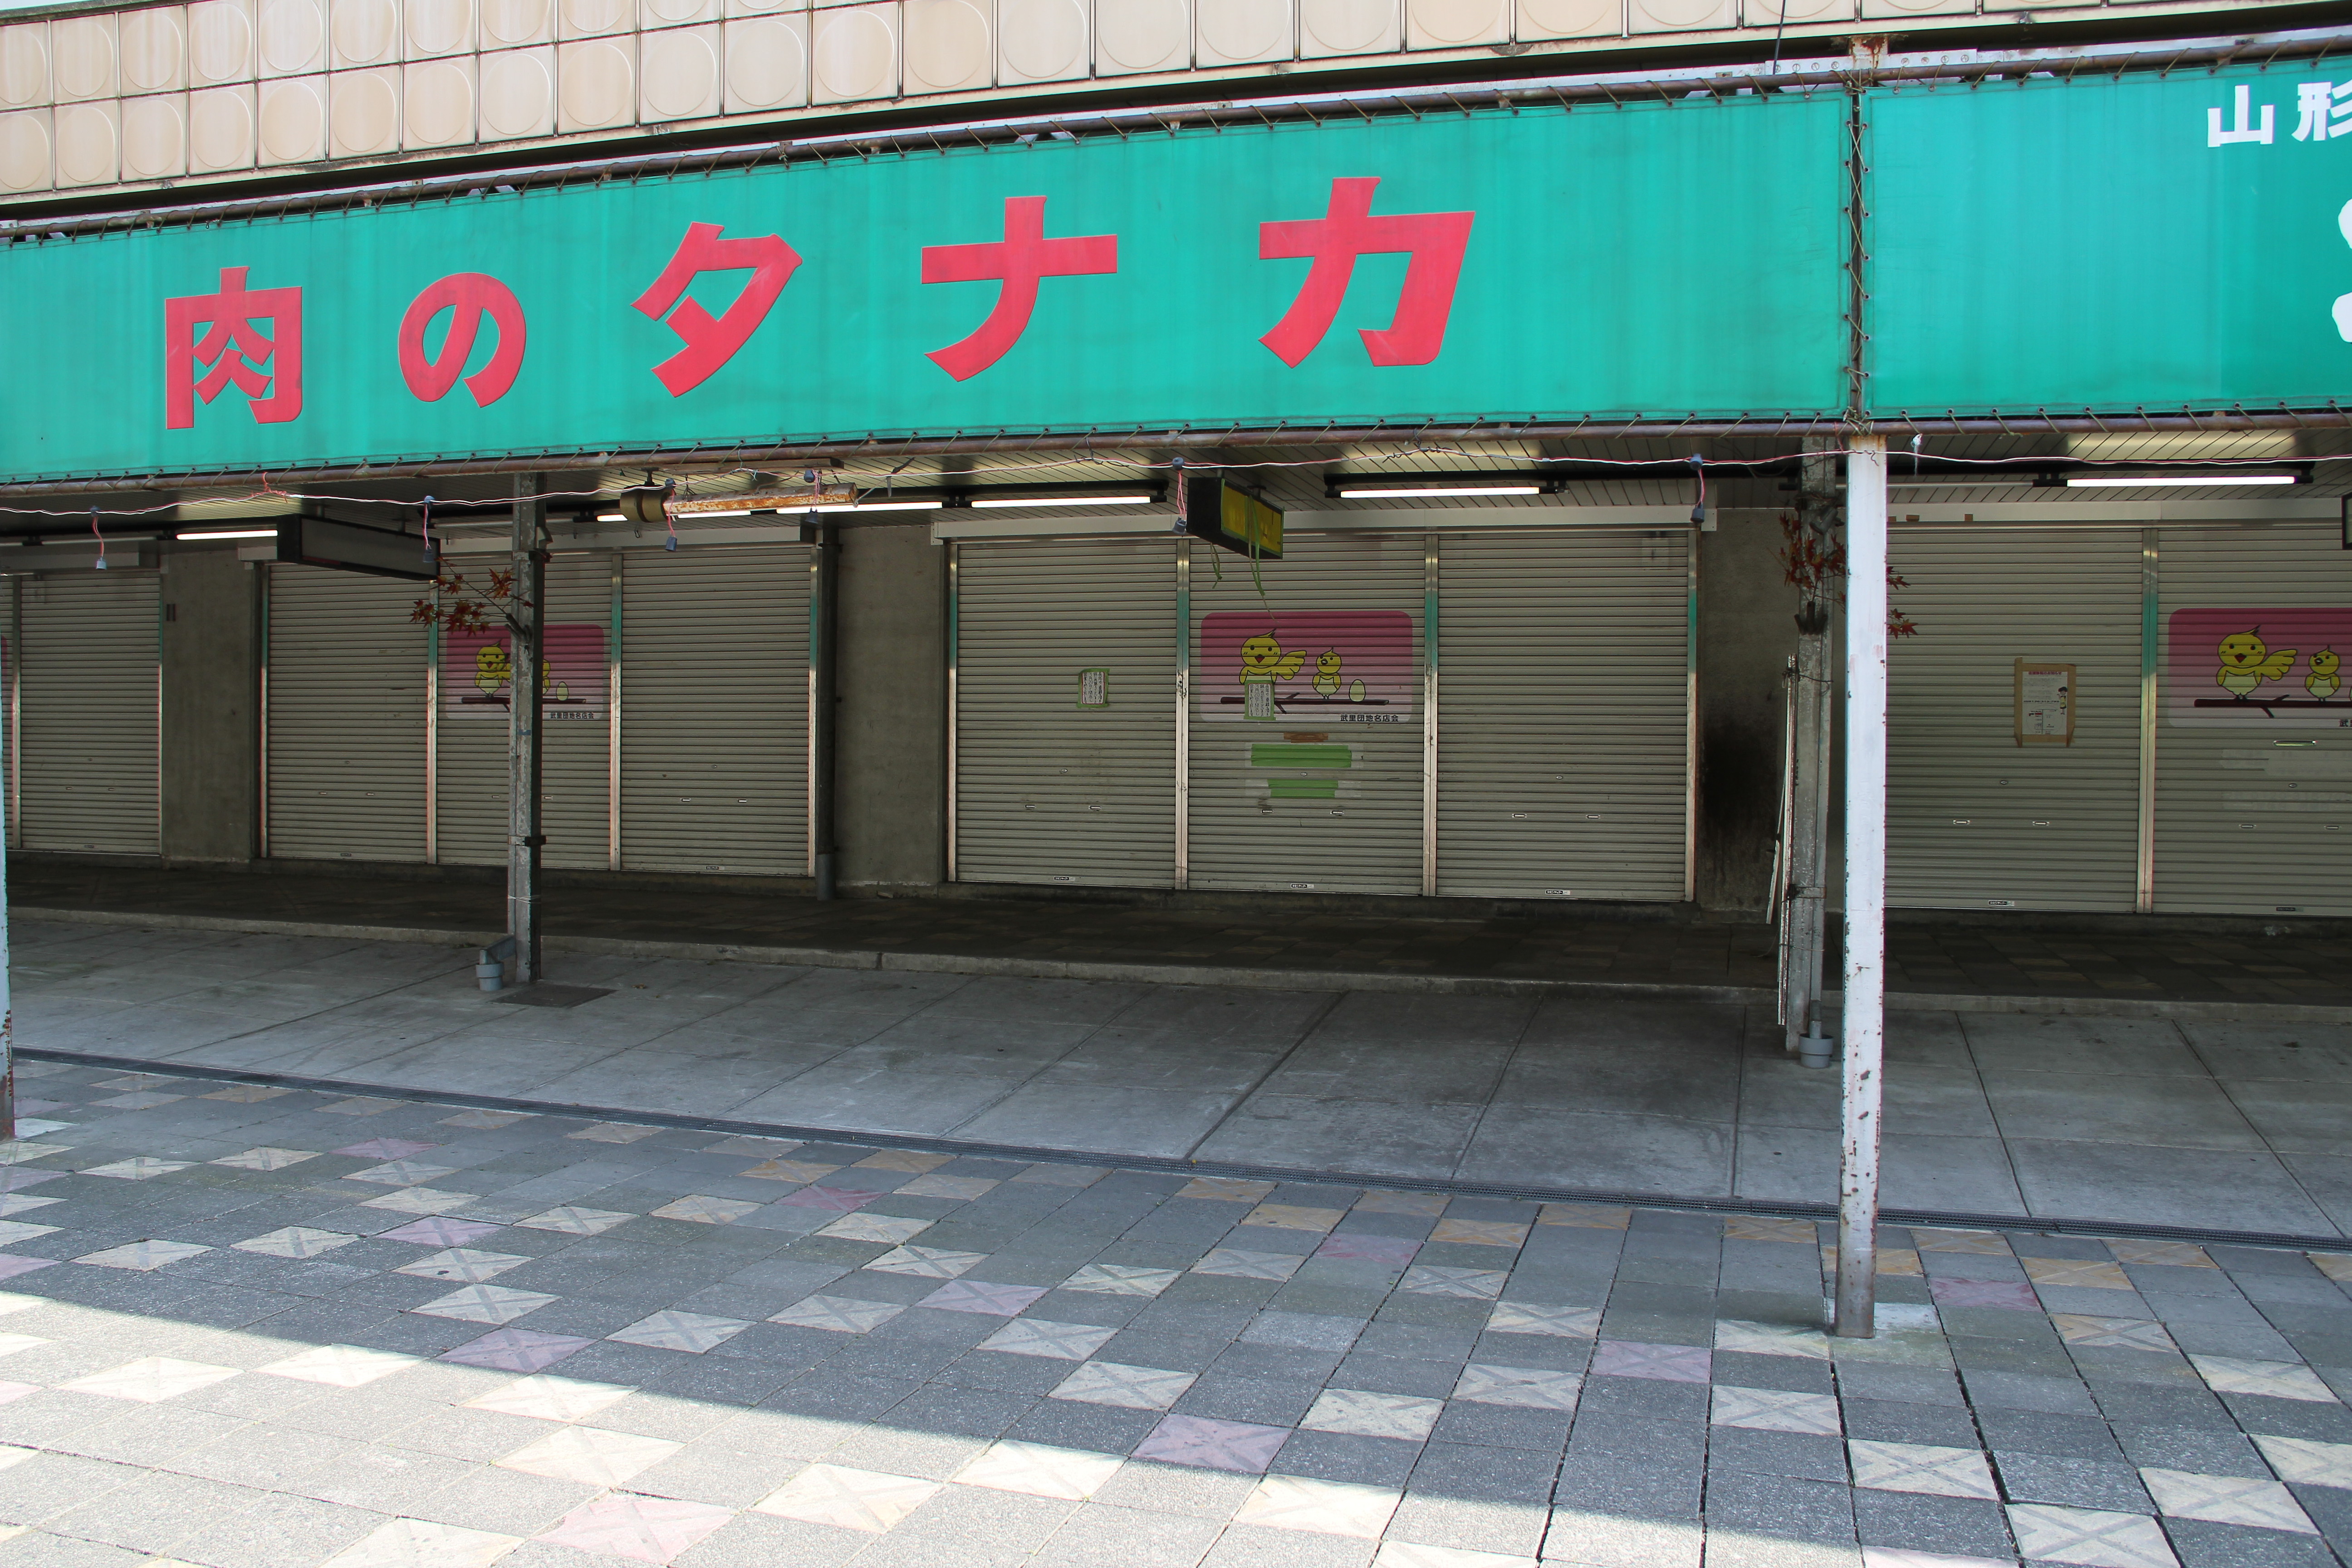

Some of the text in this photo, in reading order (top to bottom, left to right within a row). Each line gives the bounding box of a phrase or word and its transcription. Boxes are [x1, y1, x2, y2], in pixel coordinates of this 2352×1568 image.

[166, 176, 1475, 430] 肉のタナカ
[1340, 714, 1399, 722] 武里団地名店会
